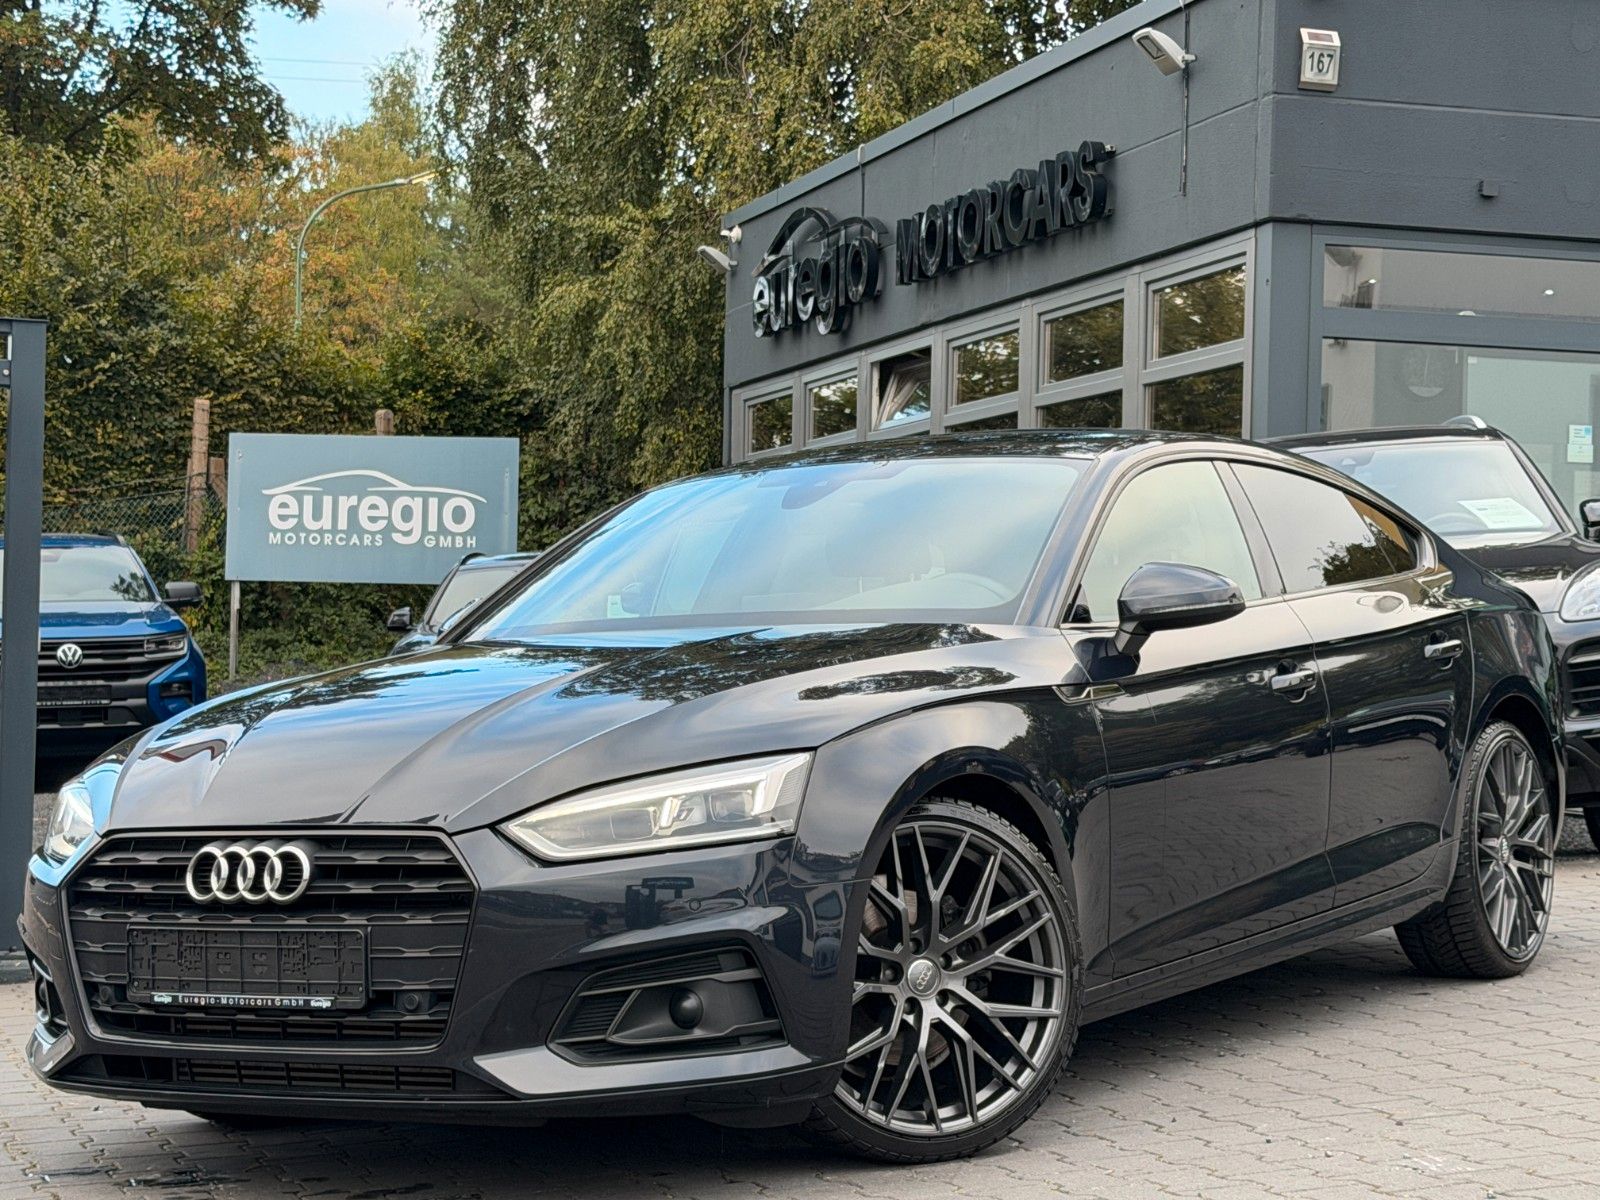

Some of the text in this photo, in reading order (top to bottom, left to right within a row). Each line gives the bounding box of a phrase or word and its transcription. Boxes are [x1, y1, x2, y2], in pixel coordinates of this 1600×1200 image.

[1309, 51, 1334, 74] 167
[896, 141, 1106, 285] MOTORCARS
[268, 494, 476, 545] euregio
[268, 532, 477, 548] MOTORCARS GMBH
